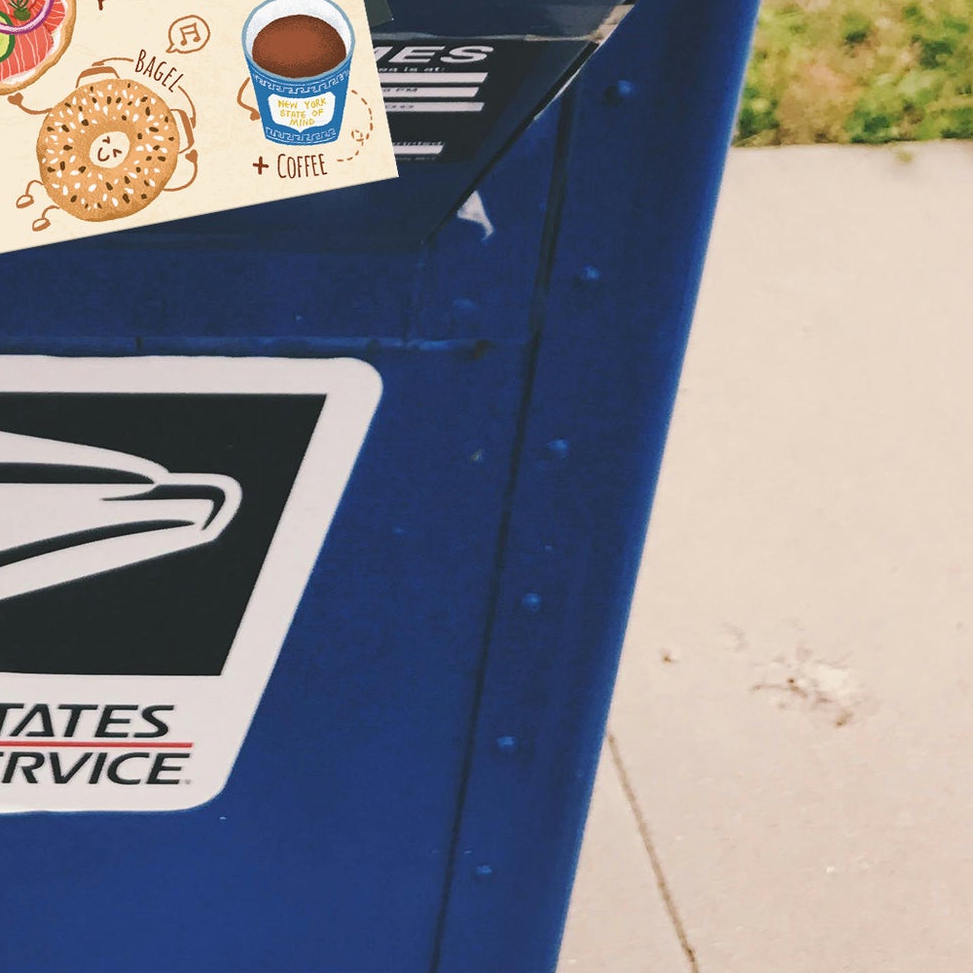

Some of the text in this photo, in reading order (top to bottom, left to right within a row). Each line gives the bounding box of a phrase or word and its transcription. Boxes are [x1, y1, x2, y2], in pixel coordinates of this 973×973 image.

[134, 48, 185, 94] BAGEL
[277, 97, 327, 109] NEW YORK
[279, 108, 324, 119] STATE OF
[289, 117, 316, 127] MIND
[277, 153, 328, 180] COFFEE
